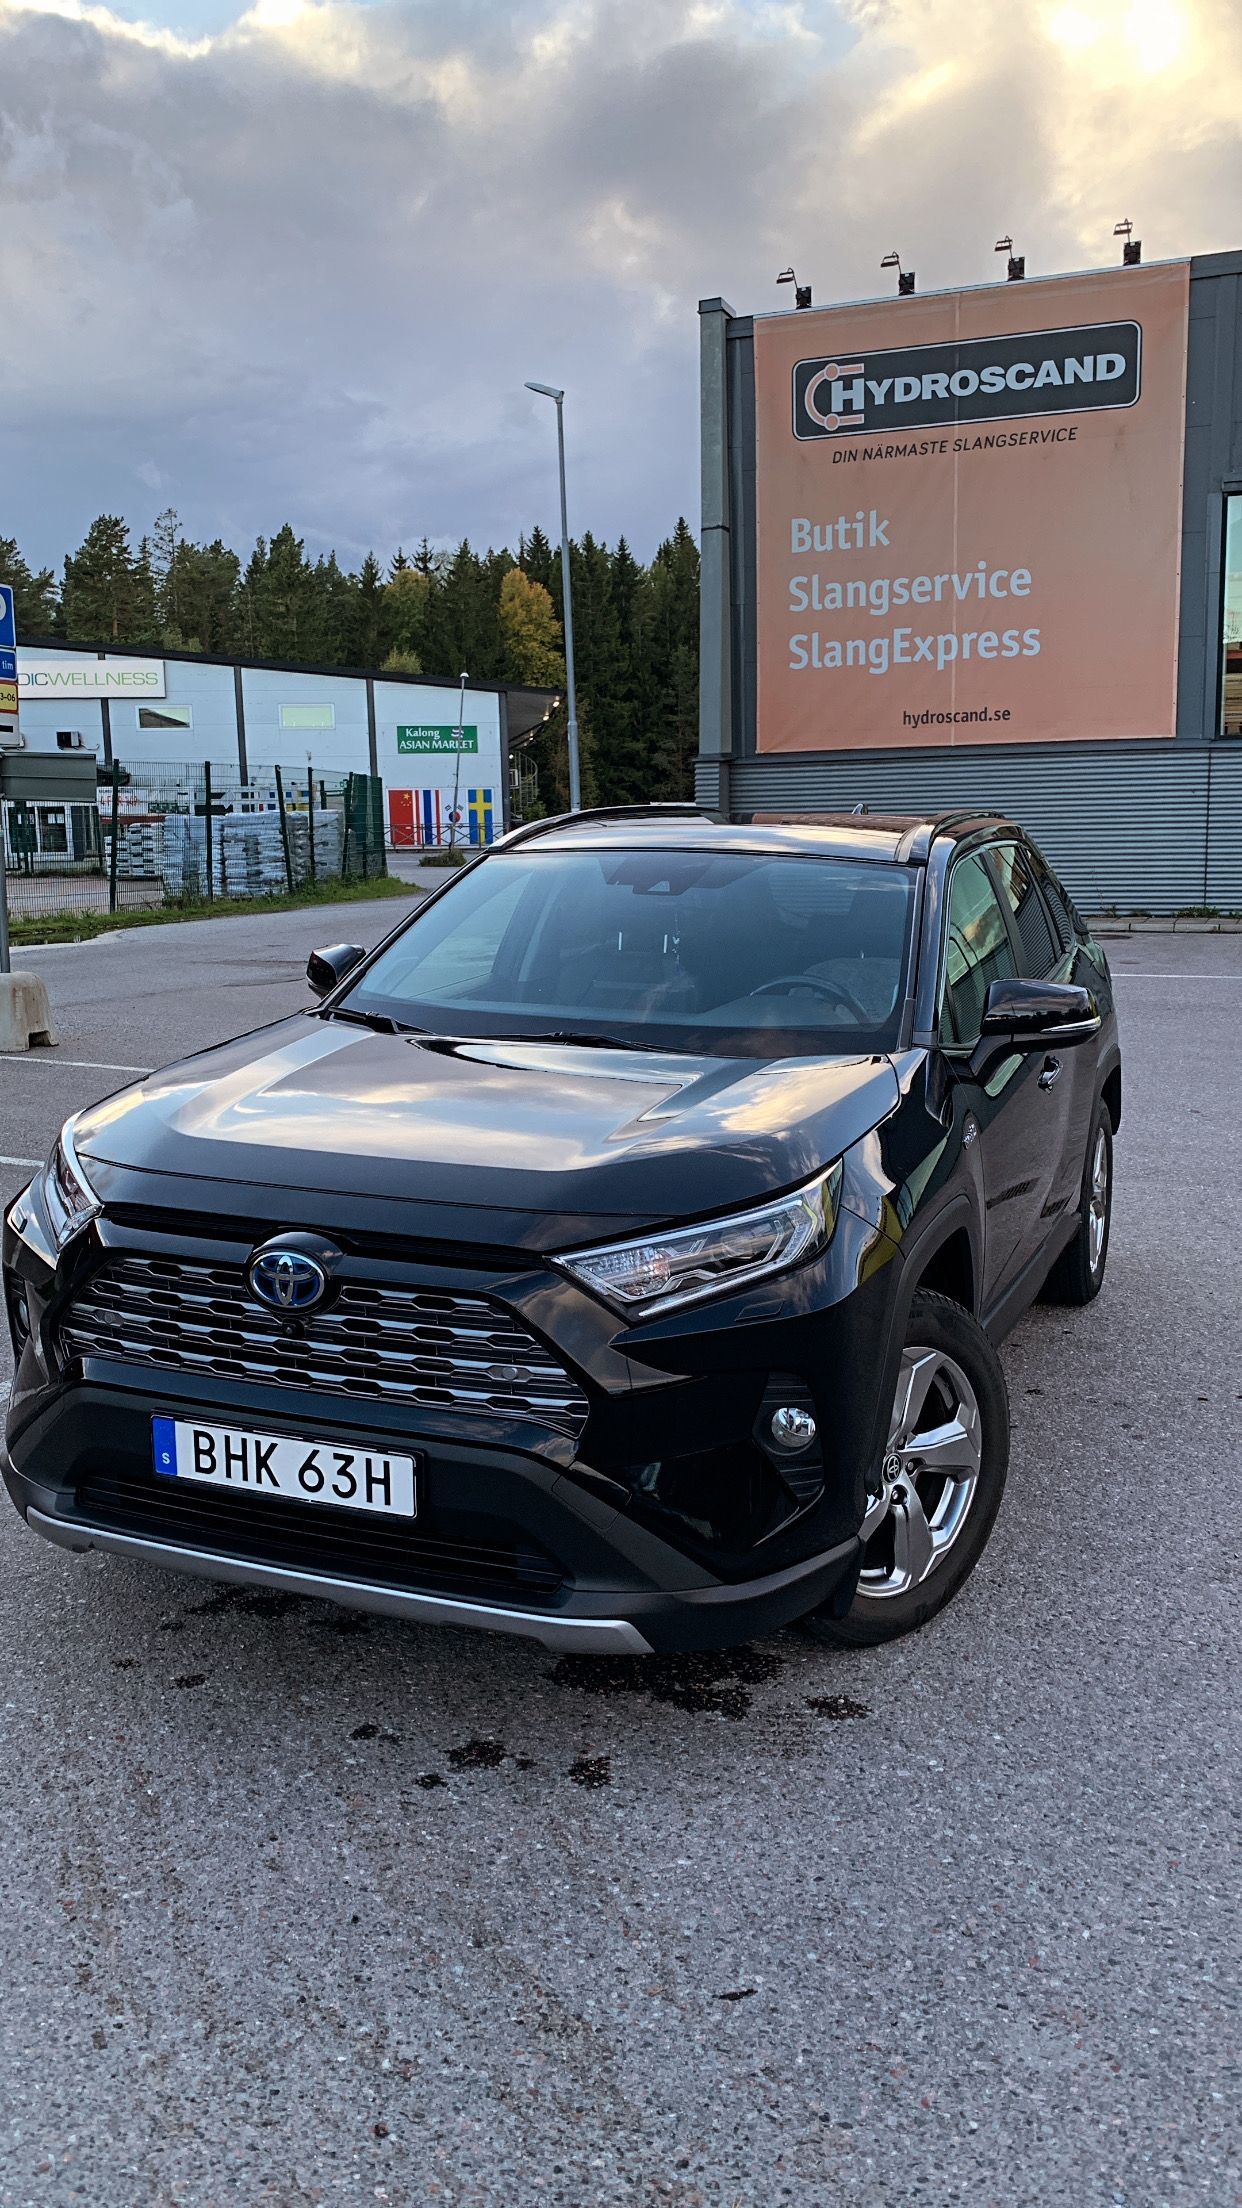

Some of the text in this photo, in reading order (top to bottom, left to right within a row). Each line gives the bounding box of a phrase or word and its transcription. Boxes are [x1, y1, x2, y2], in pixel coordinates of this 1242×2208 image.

[831, 353, 1126, 413] HYDROSCAND
[832, 427, 1078, 464] DIN NÄRMASTE SLANGSERVICE
[791, 509, 890, 553] Butik
[789, 560, 1032, 616] Slangservice
[2, 660, 14, 671] tim
[789, 628, 1041, 675] SlangExpress
[406, 727, 440, 740] Kalong
[903, 707, 1011, 728] hydroscand.se
[400, 740, 430, 749] ASIAN
[162, 1452, 170, 1464] S
[193, 1429, 391, 1506] BHK 63H
